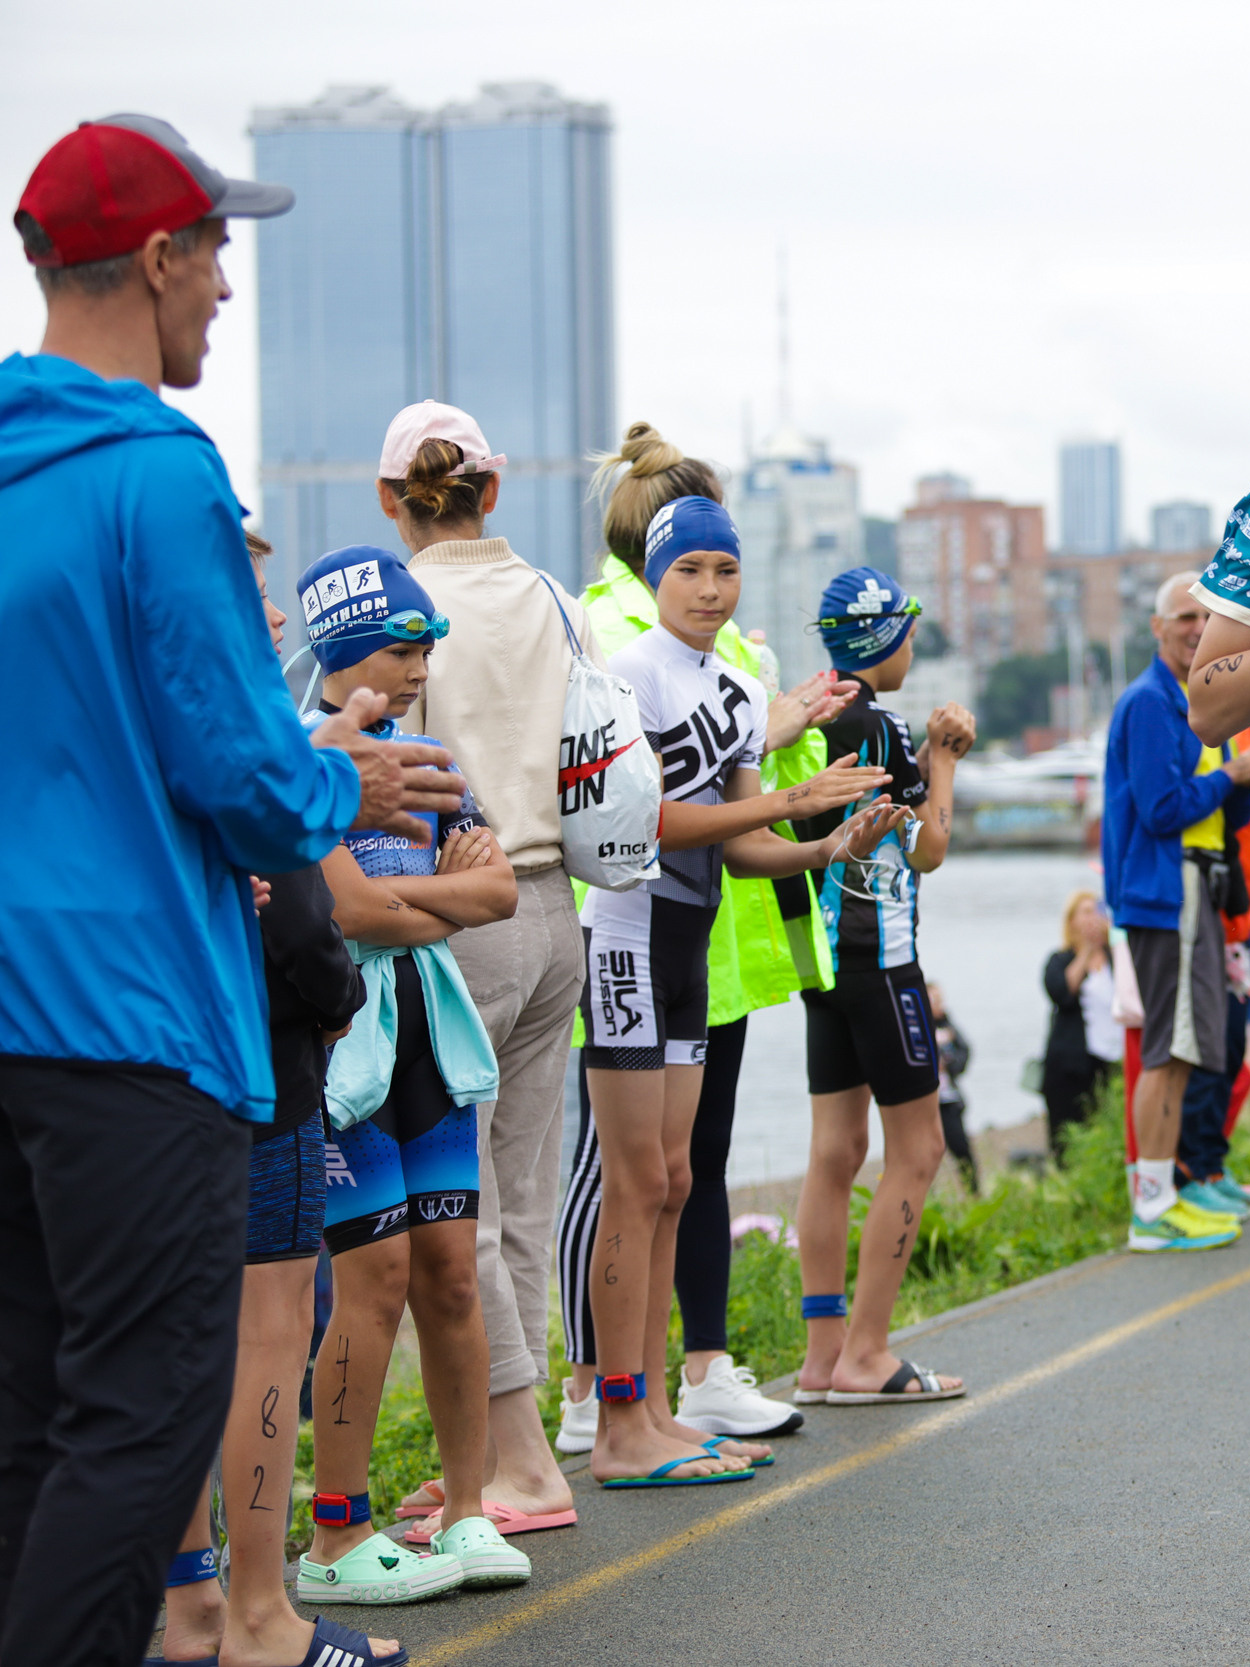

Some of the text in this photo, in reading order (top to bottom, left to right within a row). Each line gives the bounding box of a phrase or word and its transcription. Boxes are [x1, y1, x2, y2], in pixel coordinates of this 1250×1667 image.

[660, 673, 751, 796] SILA
[609, 950, 642, 1037] SILA
[351, 1581, 410, 1600] crocs
